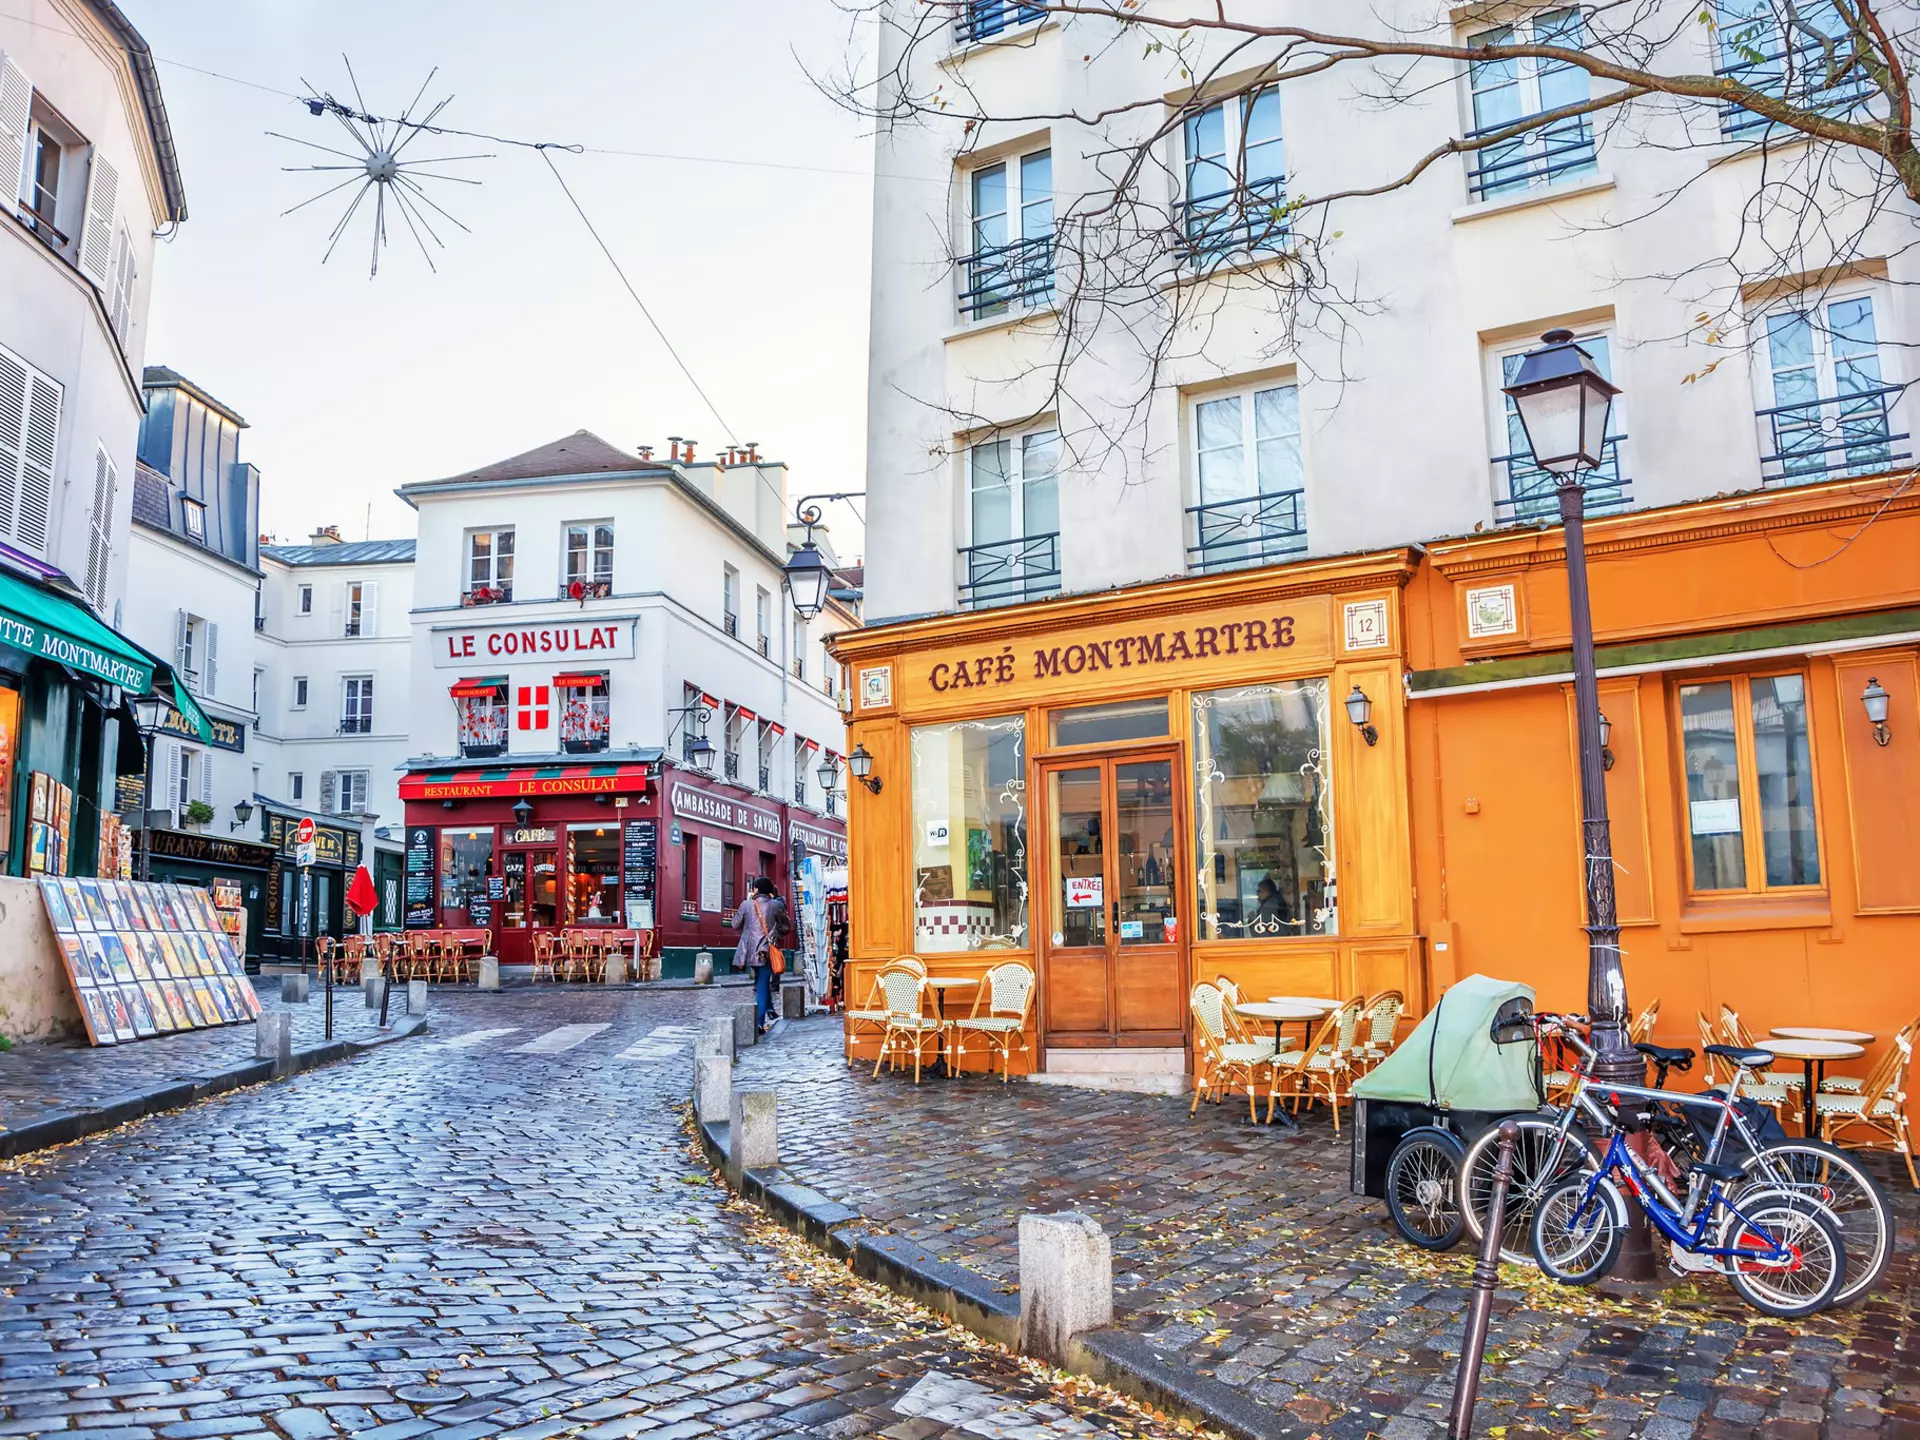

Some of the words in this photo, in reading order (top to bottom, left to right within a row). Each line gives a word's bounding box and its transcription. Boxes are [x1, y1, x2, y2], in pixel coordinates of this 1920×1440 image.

[1358, 618, 1373, 633] 12
[448, 635, 476, 658] LE
[487, 626, 619, 656] CONSULAT
[928, 646, 1016, 692] CAFÉ
[1033, 615, 1296, 679] MONTMARTRE
[41, 634, 144, 688] MONTMARTRE
[424, 785, 493, 797] RESTAURANT
[519, 781, 537, 794] LE
[542, 777, 618, 793] CONSULAT
[676, 791, 732, 821] AMBASSADE
[737, 808, 748, 826] DE
[753, 813, 778, 836] SAVOIE
[830, 837, 838, 852] LE
[1071, 877, 1102, 892] ENTRÉE
